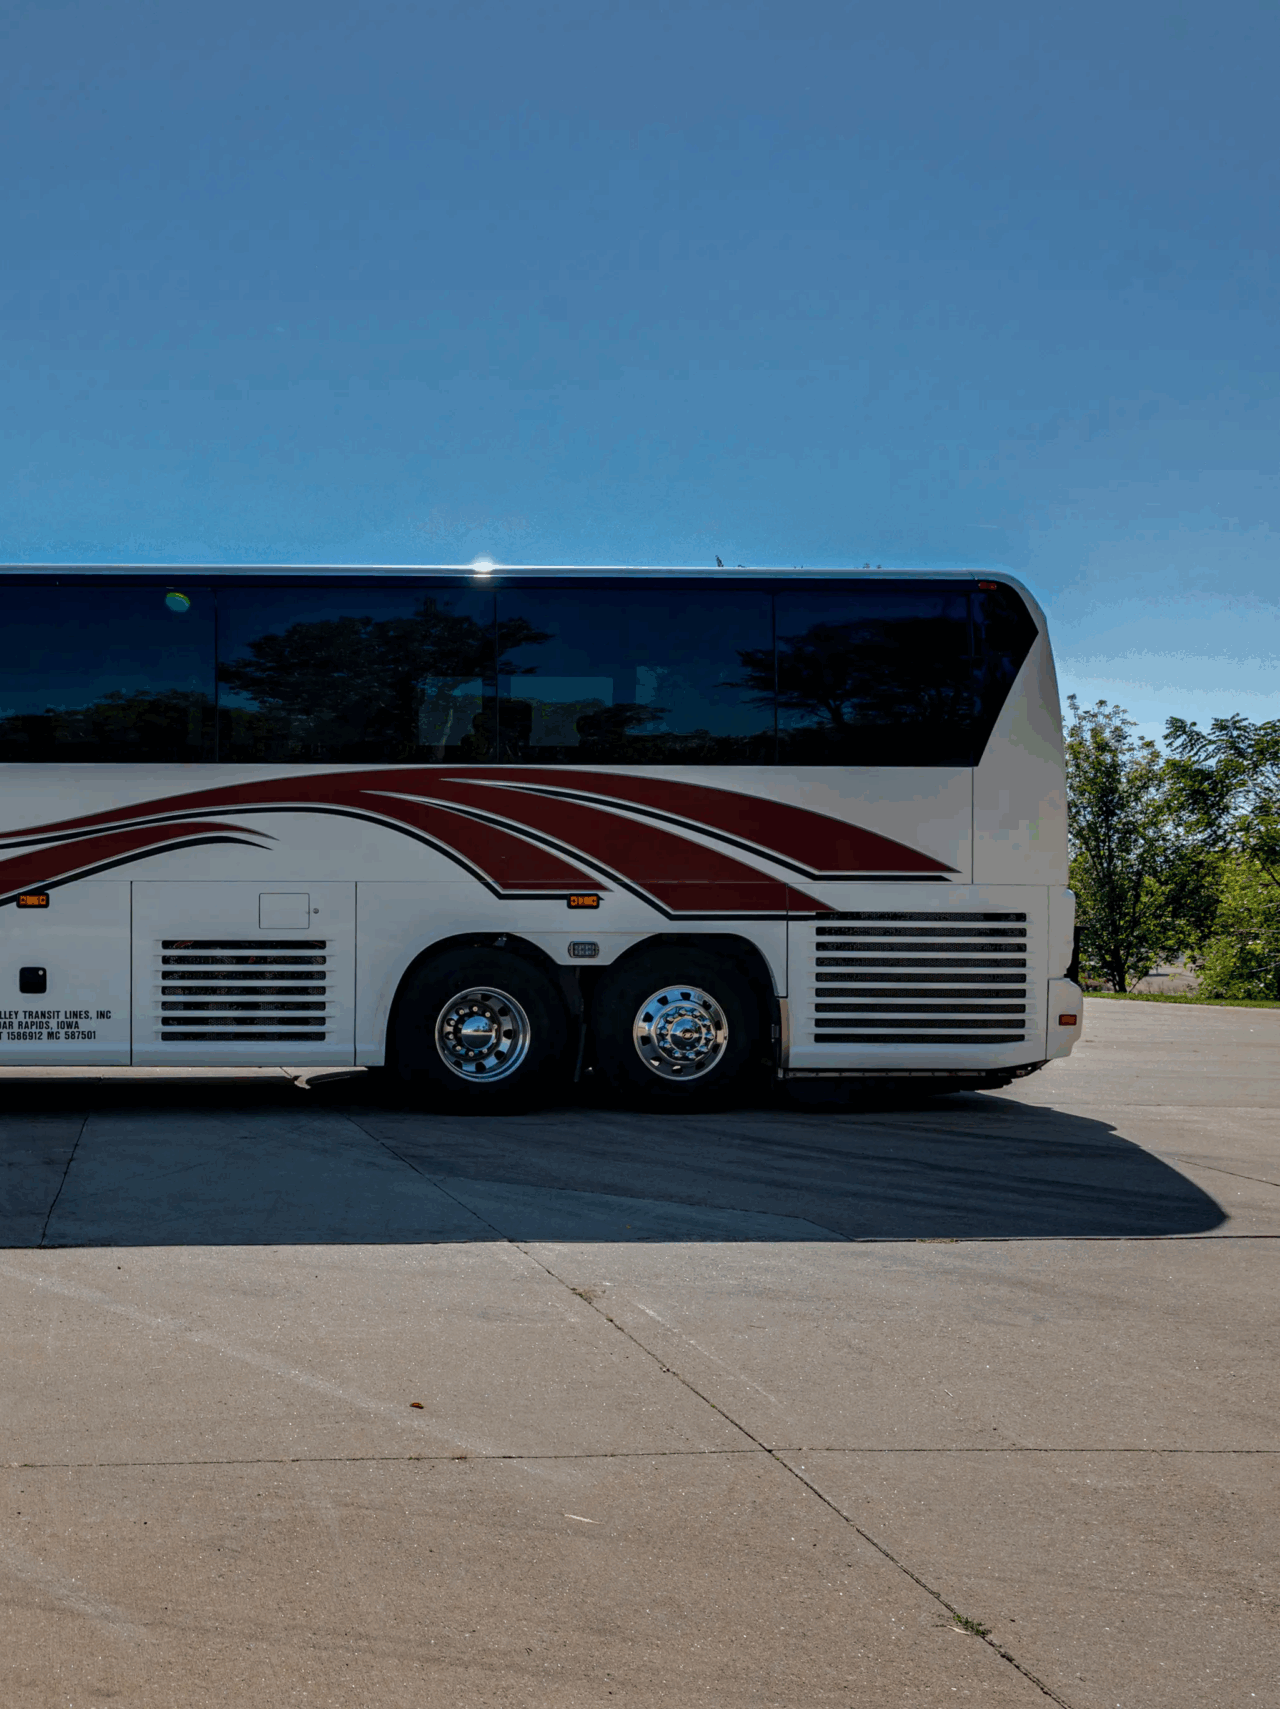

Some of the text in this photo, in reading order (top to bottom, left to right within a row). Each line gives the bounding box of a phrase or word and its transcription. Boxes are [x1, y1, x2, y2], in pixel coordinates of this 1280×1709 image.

[22, 1010, 61, 1020] TRANSIT
[64, 1010, 92, 1021] LINES,
[96, 1010, 112, 1020] INC
[18, 1020, 53, 1031] RAPIDS,
[57, 1020, 80, 1030] IOWA
[6, 1031, 43, 1041] 1586912
[47, 1031, 61, 1041] MC
[64, 1030, 96, 1040] 587501
